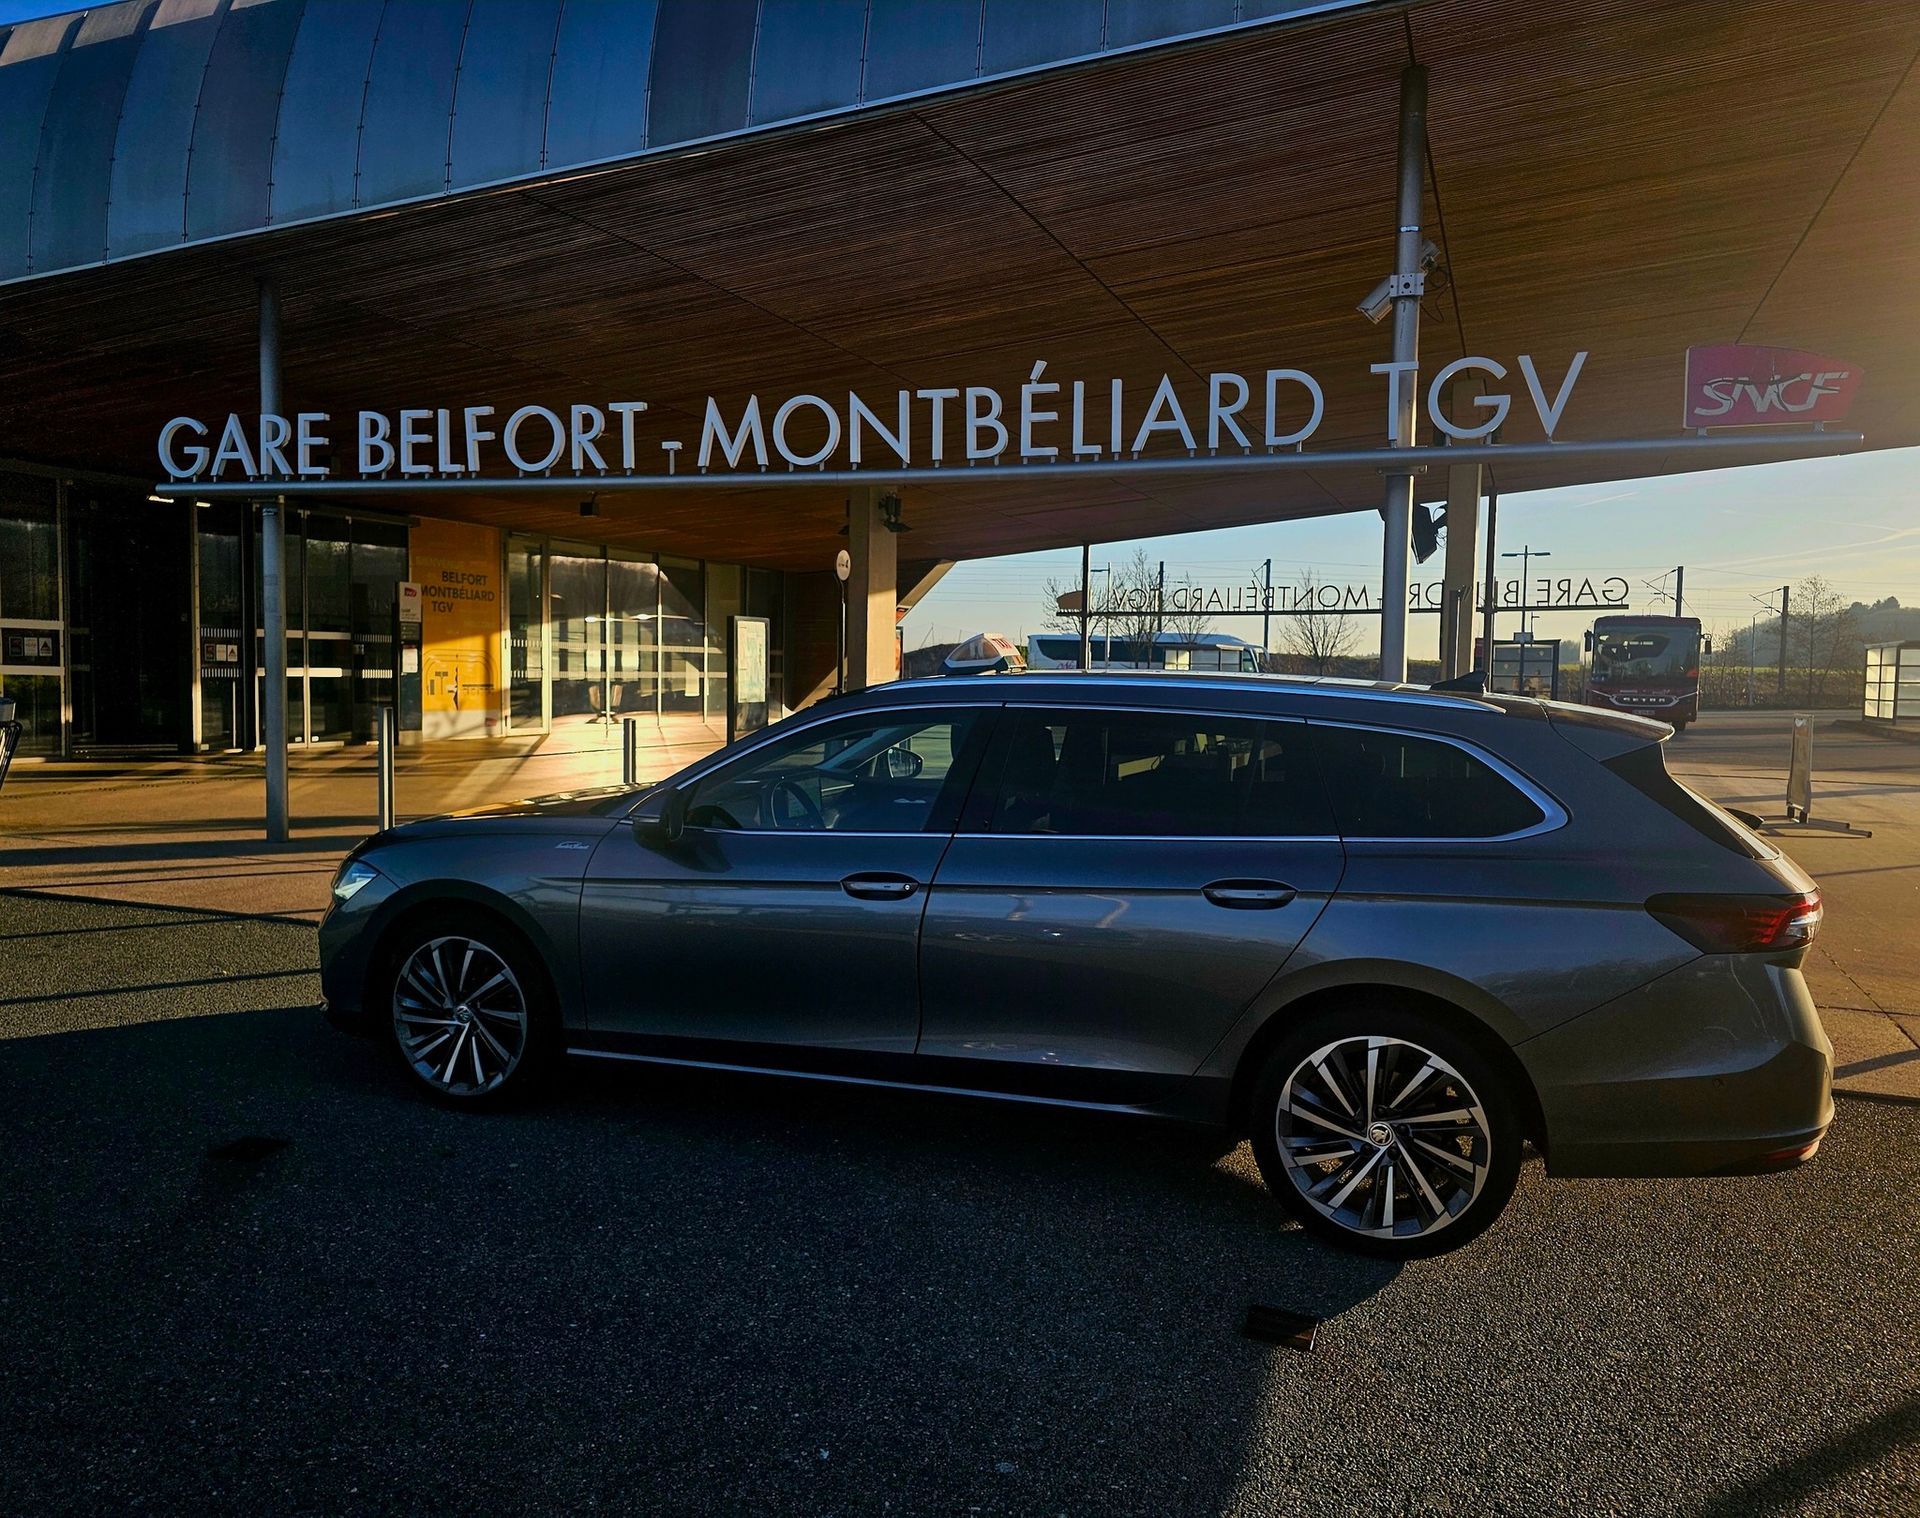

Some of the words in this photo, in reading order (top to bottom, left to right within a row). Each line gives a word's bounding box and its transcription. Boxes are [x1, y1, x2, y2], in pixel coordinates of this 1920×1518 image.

[1693, 371, 1849, 417] SNCF
[157, 413, 331, 478] GARE
[358, 401, 648, 475] BELFORT
[696, 360, 1326, 468] MONTBÉLIARD
[1370, 351, 1589, 440] TGV
[441, 571, 488, 586] BELFORT
[420, 585, 495, 602] MONTBÉLIARD
[431, 601, 454, 613] TGV
